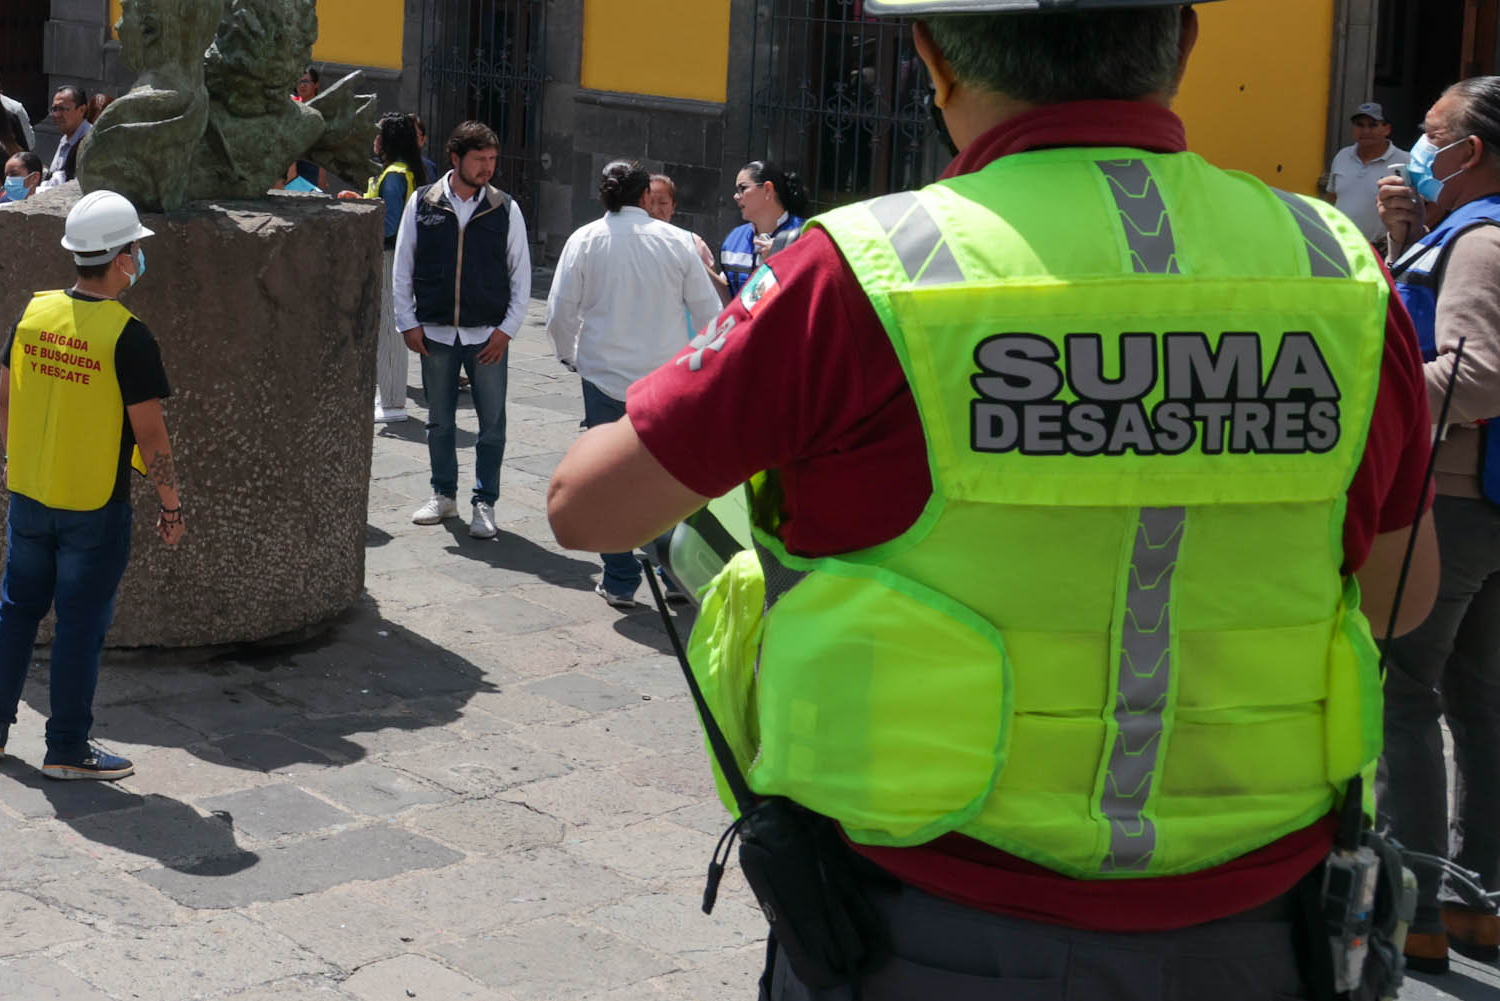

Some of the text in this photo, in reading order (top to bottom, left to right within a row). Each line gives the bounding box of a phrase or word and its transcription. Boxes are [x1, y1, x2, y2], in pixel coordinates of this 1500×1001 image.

[39, 331, 88, 352] BRIGADA
[24, 344, 101, 372] DE BUSQUEDA
[969, 331, 1342, 402] SUMA
[31, 361, 90, 385] Y RESCATE
[969, 398, 1342, 456] DESASTRES
